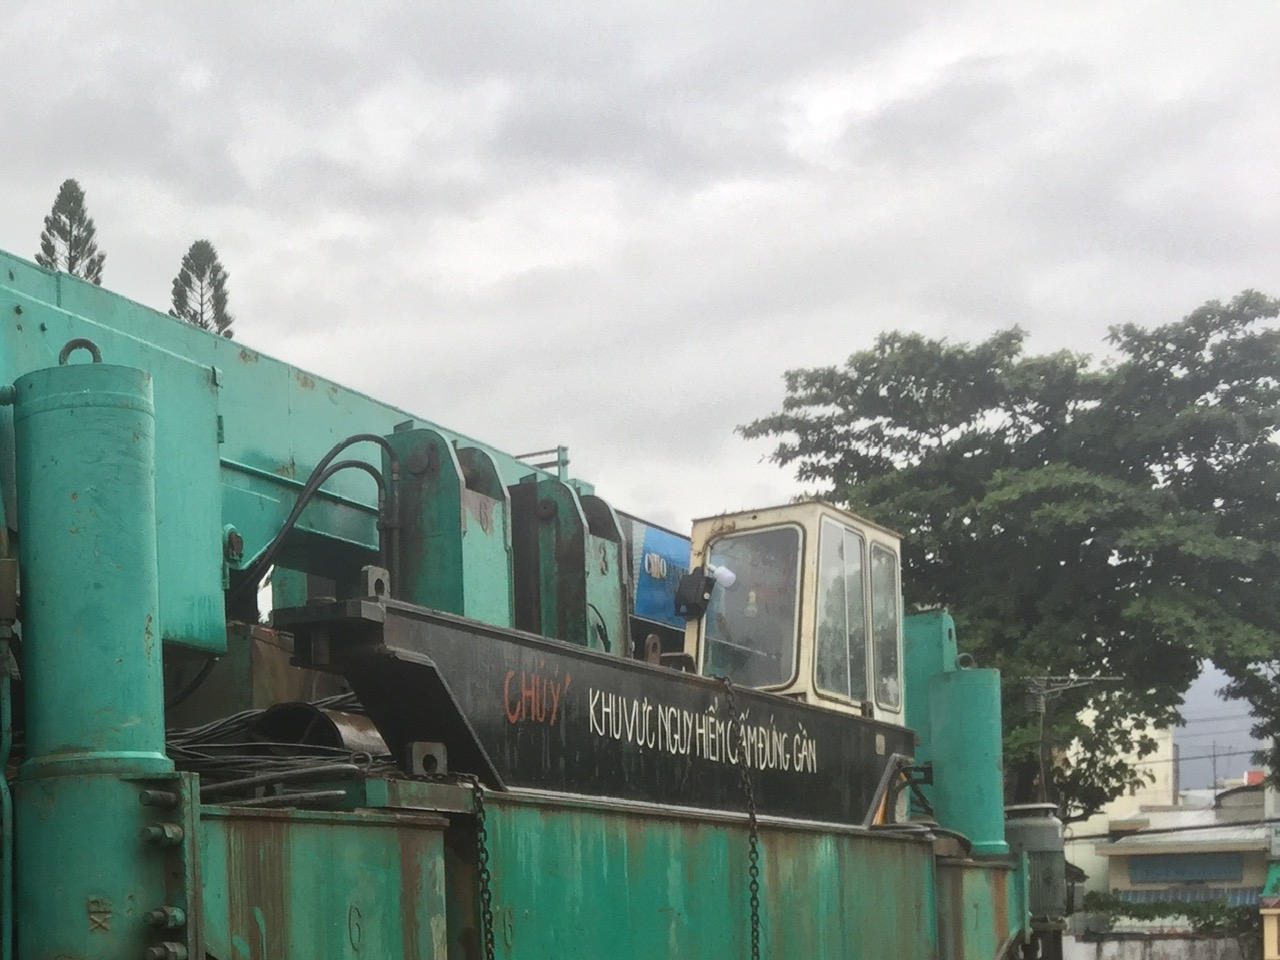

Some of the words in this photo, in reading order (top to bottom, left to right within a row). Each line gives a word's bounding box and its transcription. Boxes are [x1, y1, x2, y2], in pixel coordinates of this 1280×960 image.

[588, 687, 622, 740] KHU
[622, 697, 656, 754] VỰC
[657, 704, 694, 756] NGUY
[793, 721, 818, 774] GẦN
